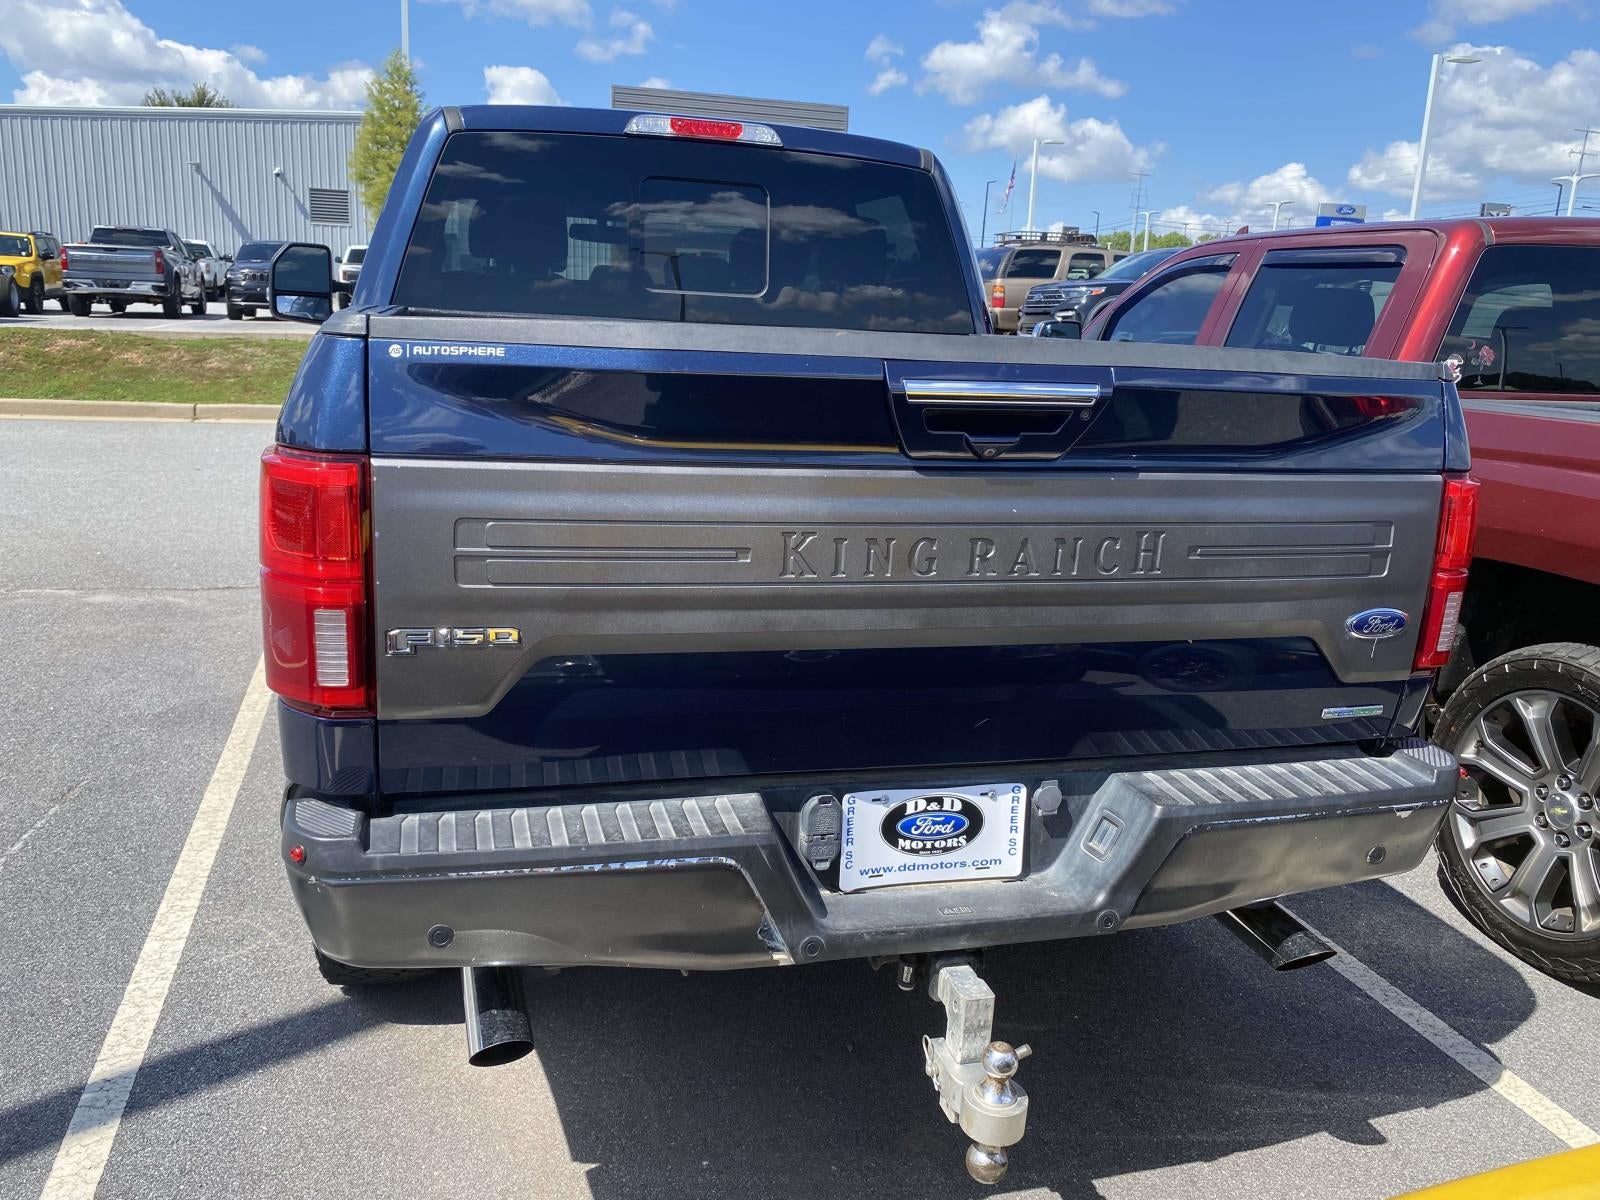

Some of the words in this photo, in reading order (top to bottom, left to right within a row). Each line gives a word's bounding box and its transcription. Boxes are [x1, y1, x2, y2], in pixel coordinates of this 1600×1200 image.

[413, 345, 506, 357] AUTOSPHERE
[779, 531, 938, 579] KING
[966, 530, 1166, 576] RANCH
[1363, 615, 1399, 633] Ford
[904, 796, 963, 816] D&D
[1010, 785, 1022, 834] GREER
[846, 795, 856, 847] GREER
[911, 816, 955, 835] Ford
[897, 835, 967, 851] MOTORS
[1008, 838, 1018, 856] SC
[844, 850, 853, 870] SC
[859, 857, 1002, 877] www.ddmotors.com
